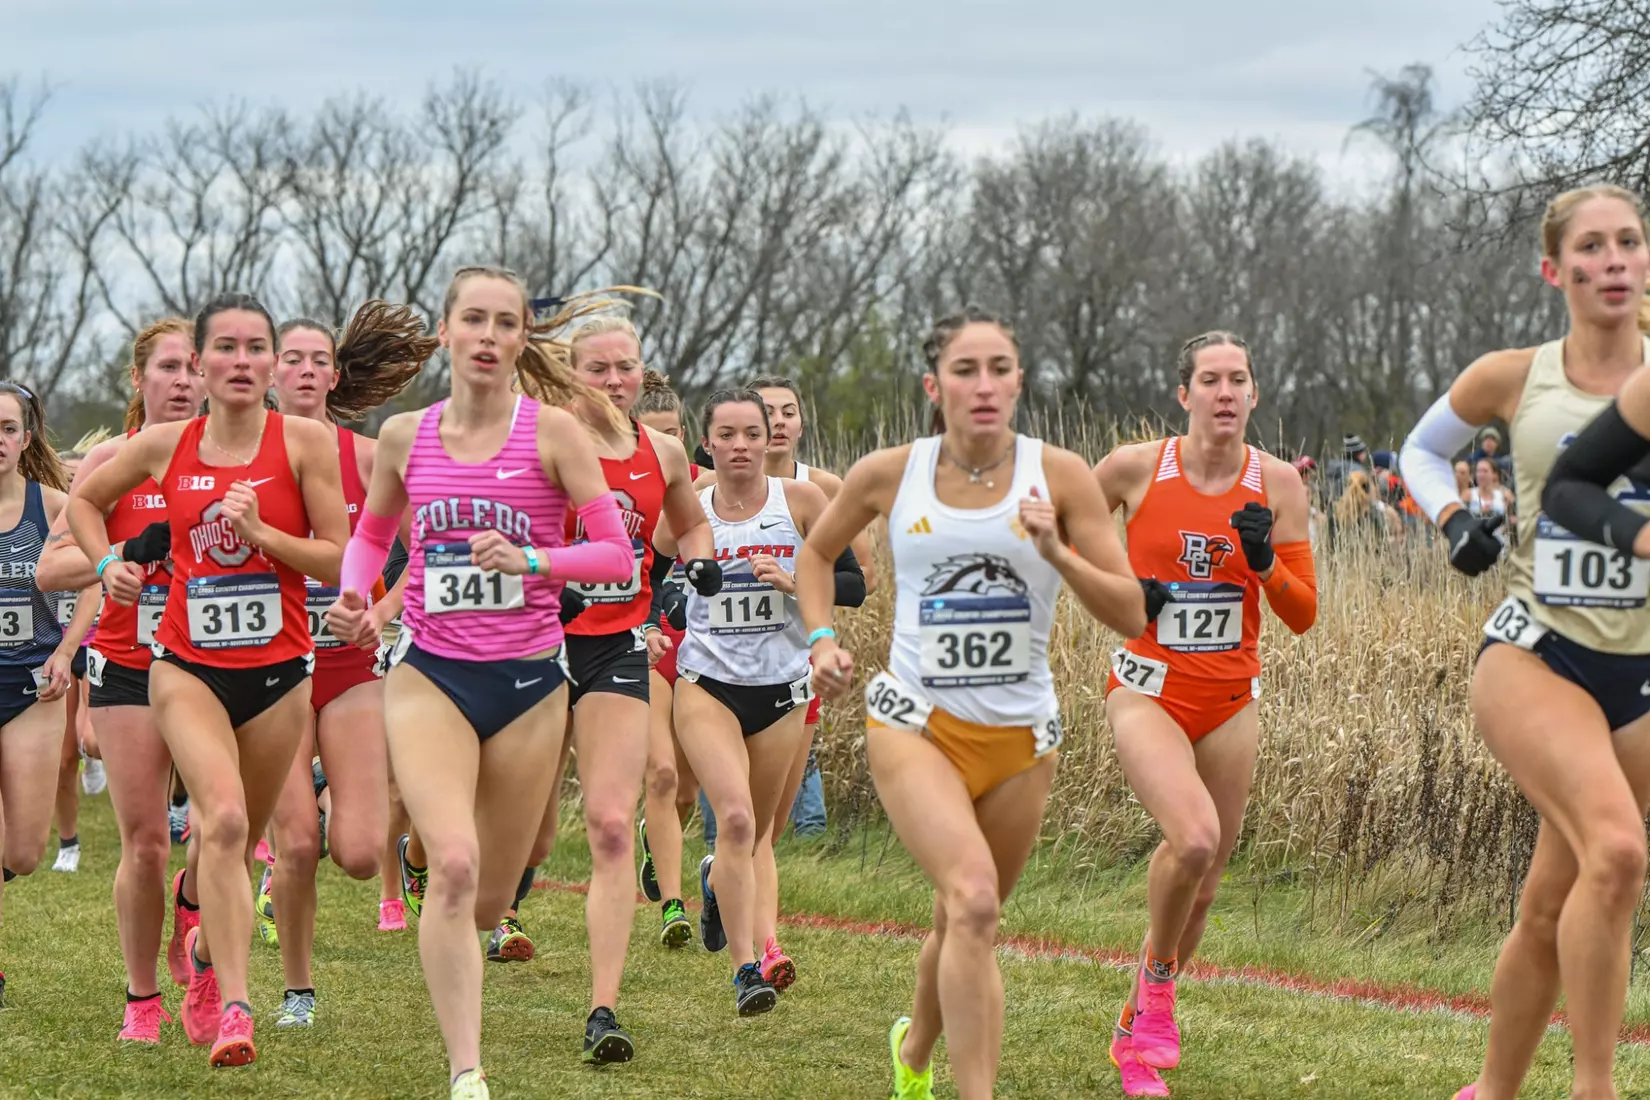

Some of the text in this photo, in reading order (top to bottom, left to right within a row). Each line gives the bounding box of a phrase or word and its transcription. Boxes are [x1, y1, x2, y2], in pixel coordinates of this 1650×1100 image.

[416, 497, 532, 543] TOLEDO
[713, 544, 795, 561] LL STATE
[1554, 548, 1633, 590] 103
[0, 562, 36, 578] LER
[439, 572, 502, 607] 341
[202, 601, 267, 635] 313
[721, 596, 773, 622] 114
[1173, 608, 1231, 639] 127
[1494, 606, 1529, 642] 03
[937, 630, 1014, 669] 362
[1118, 654, 1155, 687] 127
[869, 681, 915, 724] 362
